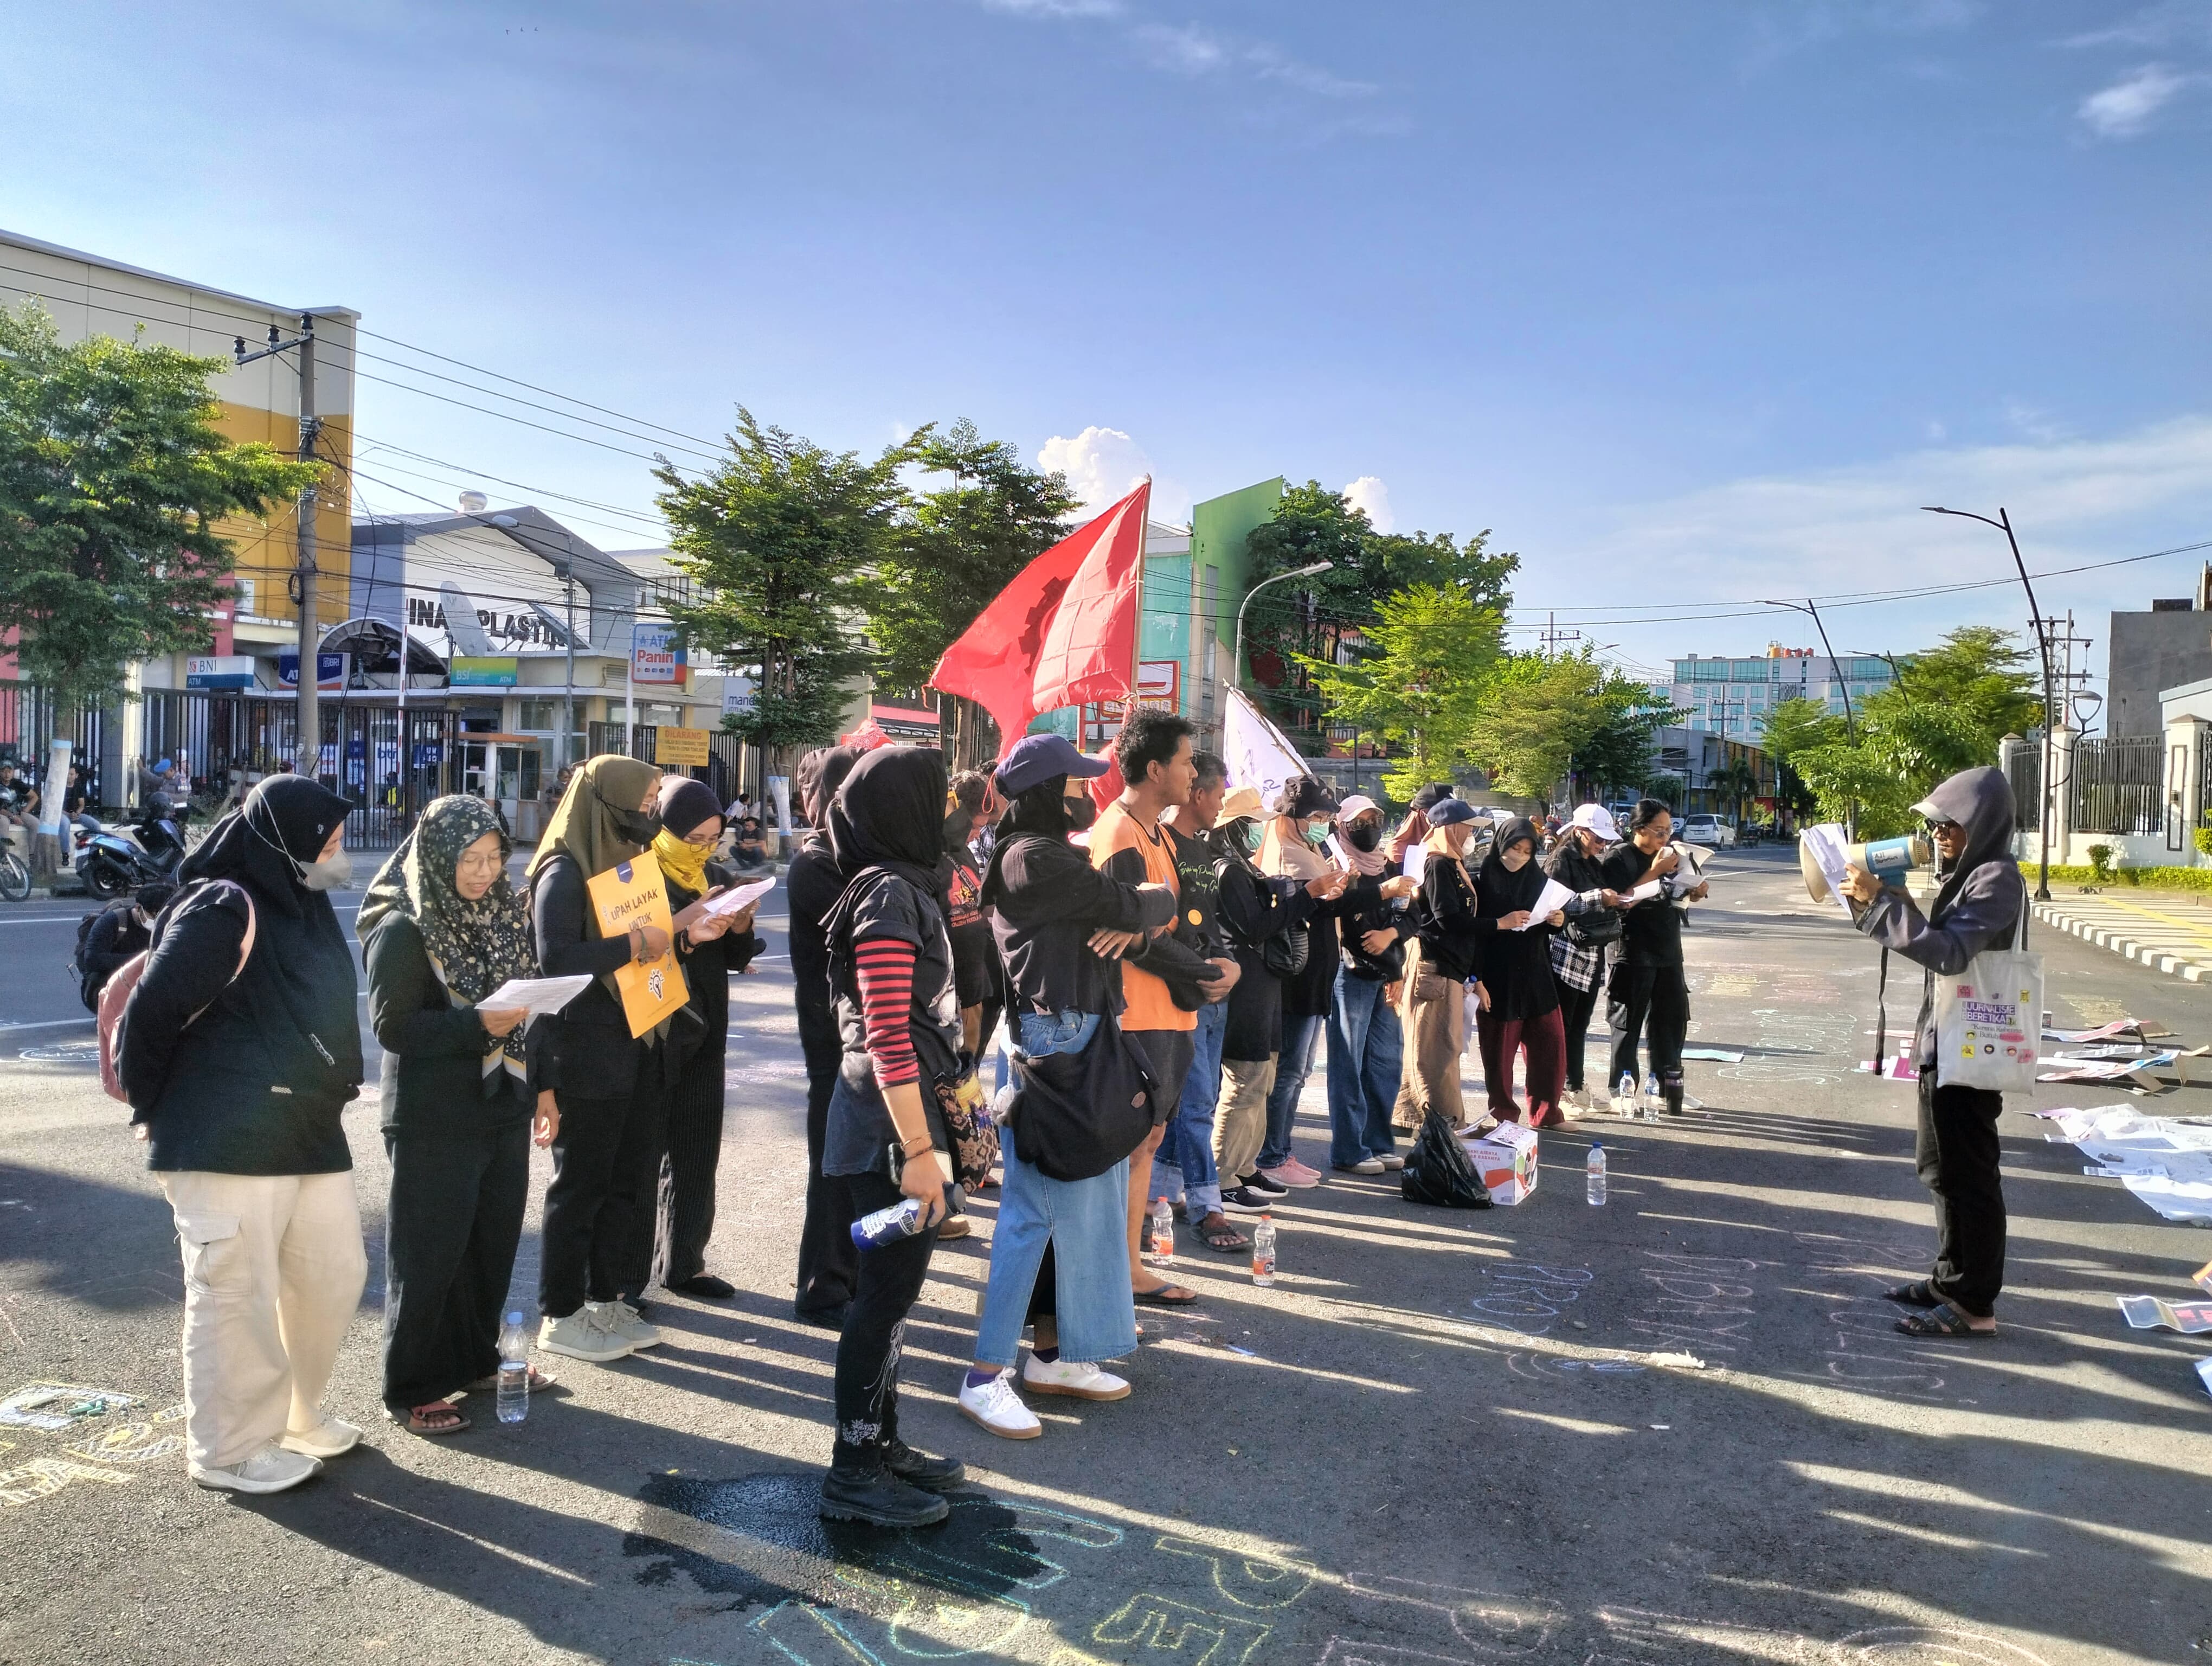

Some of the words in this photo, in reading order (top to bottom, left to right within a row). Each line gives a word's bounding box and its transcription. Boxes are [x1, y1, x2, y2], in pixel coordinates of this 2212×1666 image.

[637, 650, 673, 663] Panin
[200, 660, 216, 672] BNI
[287, 670, 299, 680] AT
[456, 667, 472, 680] BSI
[728, 696, 755, 706] mand
[665, 730, 703, 739] DILARANG
[960, 871, 975, 889] SPORT
[611, 901, 632, 920] UPAH
[632, 888, 658, 909] LAYAK
[629, 912, 652, 932] UNTUK
